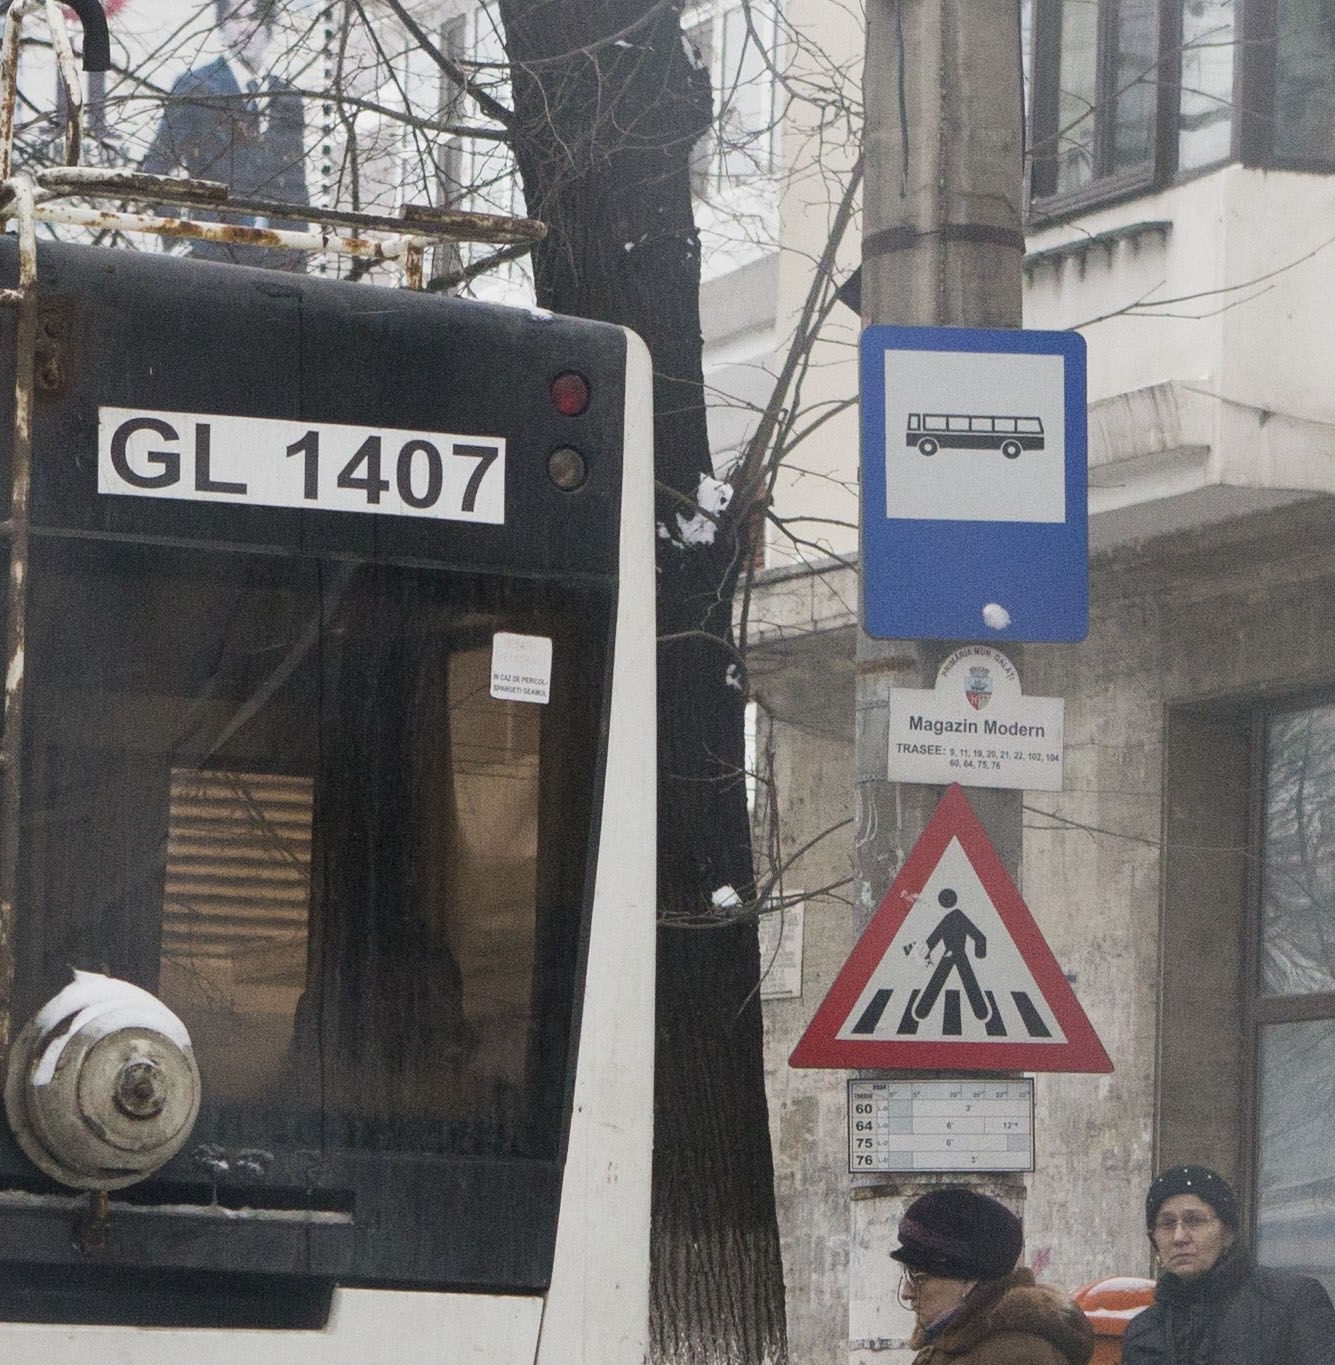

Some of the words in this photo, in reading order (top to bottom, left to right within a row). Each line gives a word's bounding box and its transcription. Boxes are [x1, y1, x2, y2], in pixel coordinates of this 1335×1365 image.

[109, 416, 248, 496] GL
[285, 430, 500, 513] 1407
[909, 715, 978, 735] Magazin
[984, 719, 1045, 737] Modern
[896, 743, 946, 755] TRASEE:
[855, 1103, 873, 1114] 60
[855, 1121, 873, 1132] 64
[855, 1138, 873, 1149] 75
[855, 1155, 873, 1166] 76
